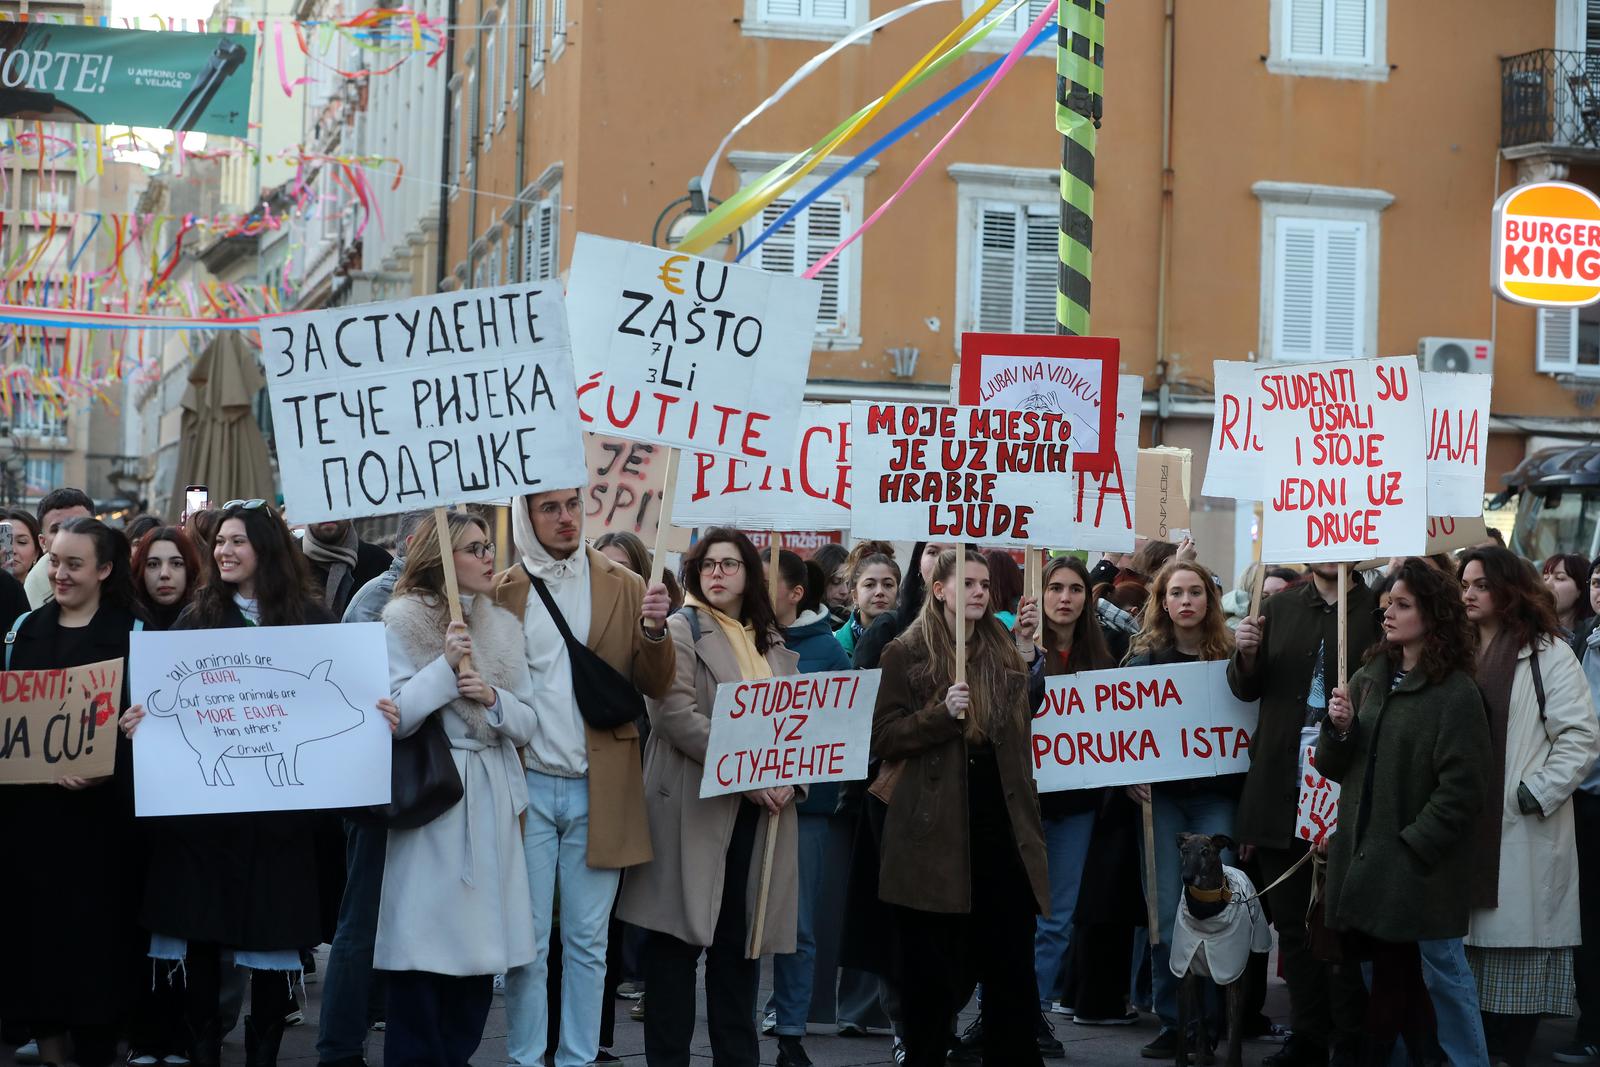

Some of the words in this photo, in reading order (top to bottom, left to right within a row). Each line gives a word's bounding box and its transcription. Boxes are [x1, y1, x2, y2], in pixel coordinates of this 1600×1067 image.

[178, 72, 191, 80] OD
[1505, 220, 1600, 248] BURGER
[1505, 244, 1600, 281] KING
[617, 290, 762, 357] ZAŠTO
[980, 366, 1018, 402] LJUBAV
[1022, 361, 1044, 383] NA
[1048, 363, 1098, 401] VIDIKU
[1261, 368, 1356, 411] STUDENTI
[1376, 365, 1409, 401] SU
[282, 386, 390, 448] ТЕЧЕ
[576, 371, 771, 458] ĆUTITE
[868, 405, 957, 437] MOJE
[969, 409, 1072, 442] MJESTO
[1309, 403, 1374, 433] USTALI
[889, 439, 928, 471] JE
[941, 440, 987, 472] UZ
[996, 443, 1069, 473] NJIH
[1296, 436, 1301, 466] I
[1313, 433, 1385, 467] STOJE
[322, 428, 541, 510] ПОДРШКЕ
[879, 472, 997, 503] HRABRE
[1159, 465, 1168, 537] FABRIANO
[1272, 477, 1346, 512] JEDNI
[928, 503, 1034, 539] LJUDE
[1307, 510, 1381, 548] DRUGE
[196, 652, 251, 670] animals
[255, 654, 272, 666] are
[0, 669, 73, 704] DENTI:
[179, 694, 199, 709] but
[205, 693, 235, 706] some
[239, 689, 279, 701] animals
[281, 689, 296, 699] are
[730, 676, 859, 719] STUDENTI
[1095, 678, 1182, 712] PISMA
[44, 701, 97, 764] ĆU!
[196, 707, 237, 725] MORE
[244, 704, 288, 720] EQUAL
[214, 726, 240, 737] than
[716, 743, 845, 786] СТУДЕНТЕ
[1032, 729, 1160, 769] PORUKA
[1181, 726, 1250, 758] ISTA
